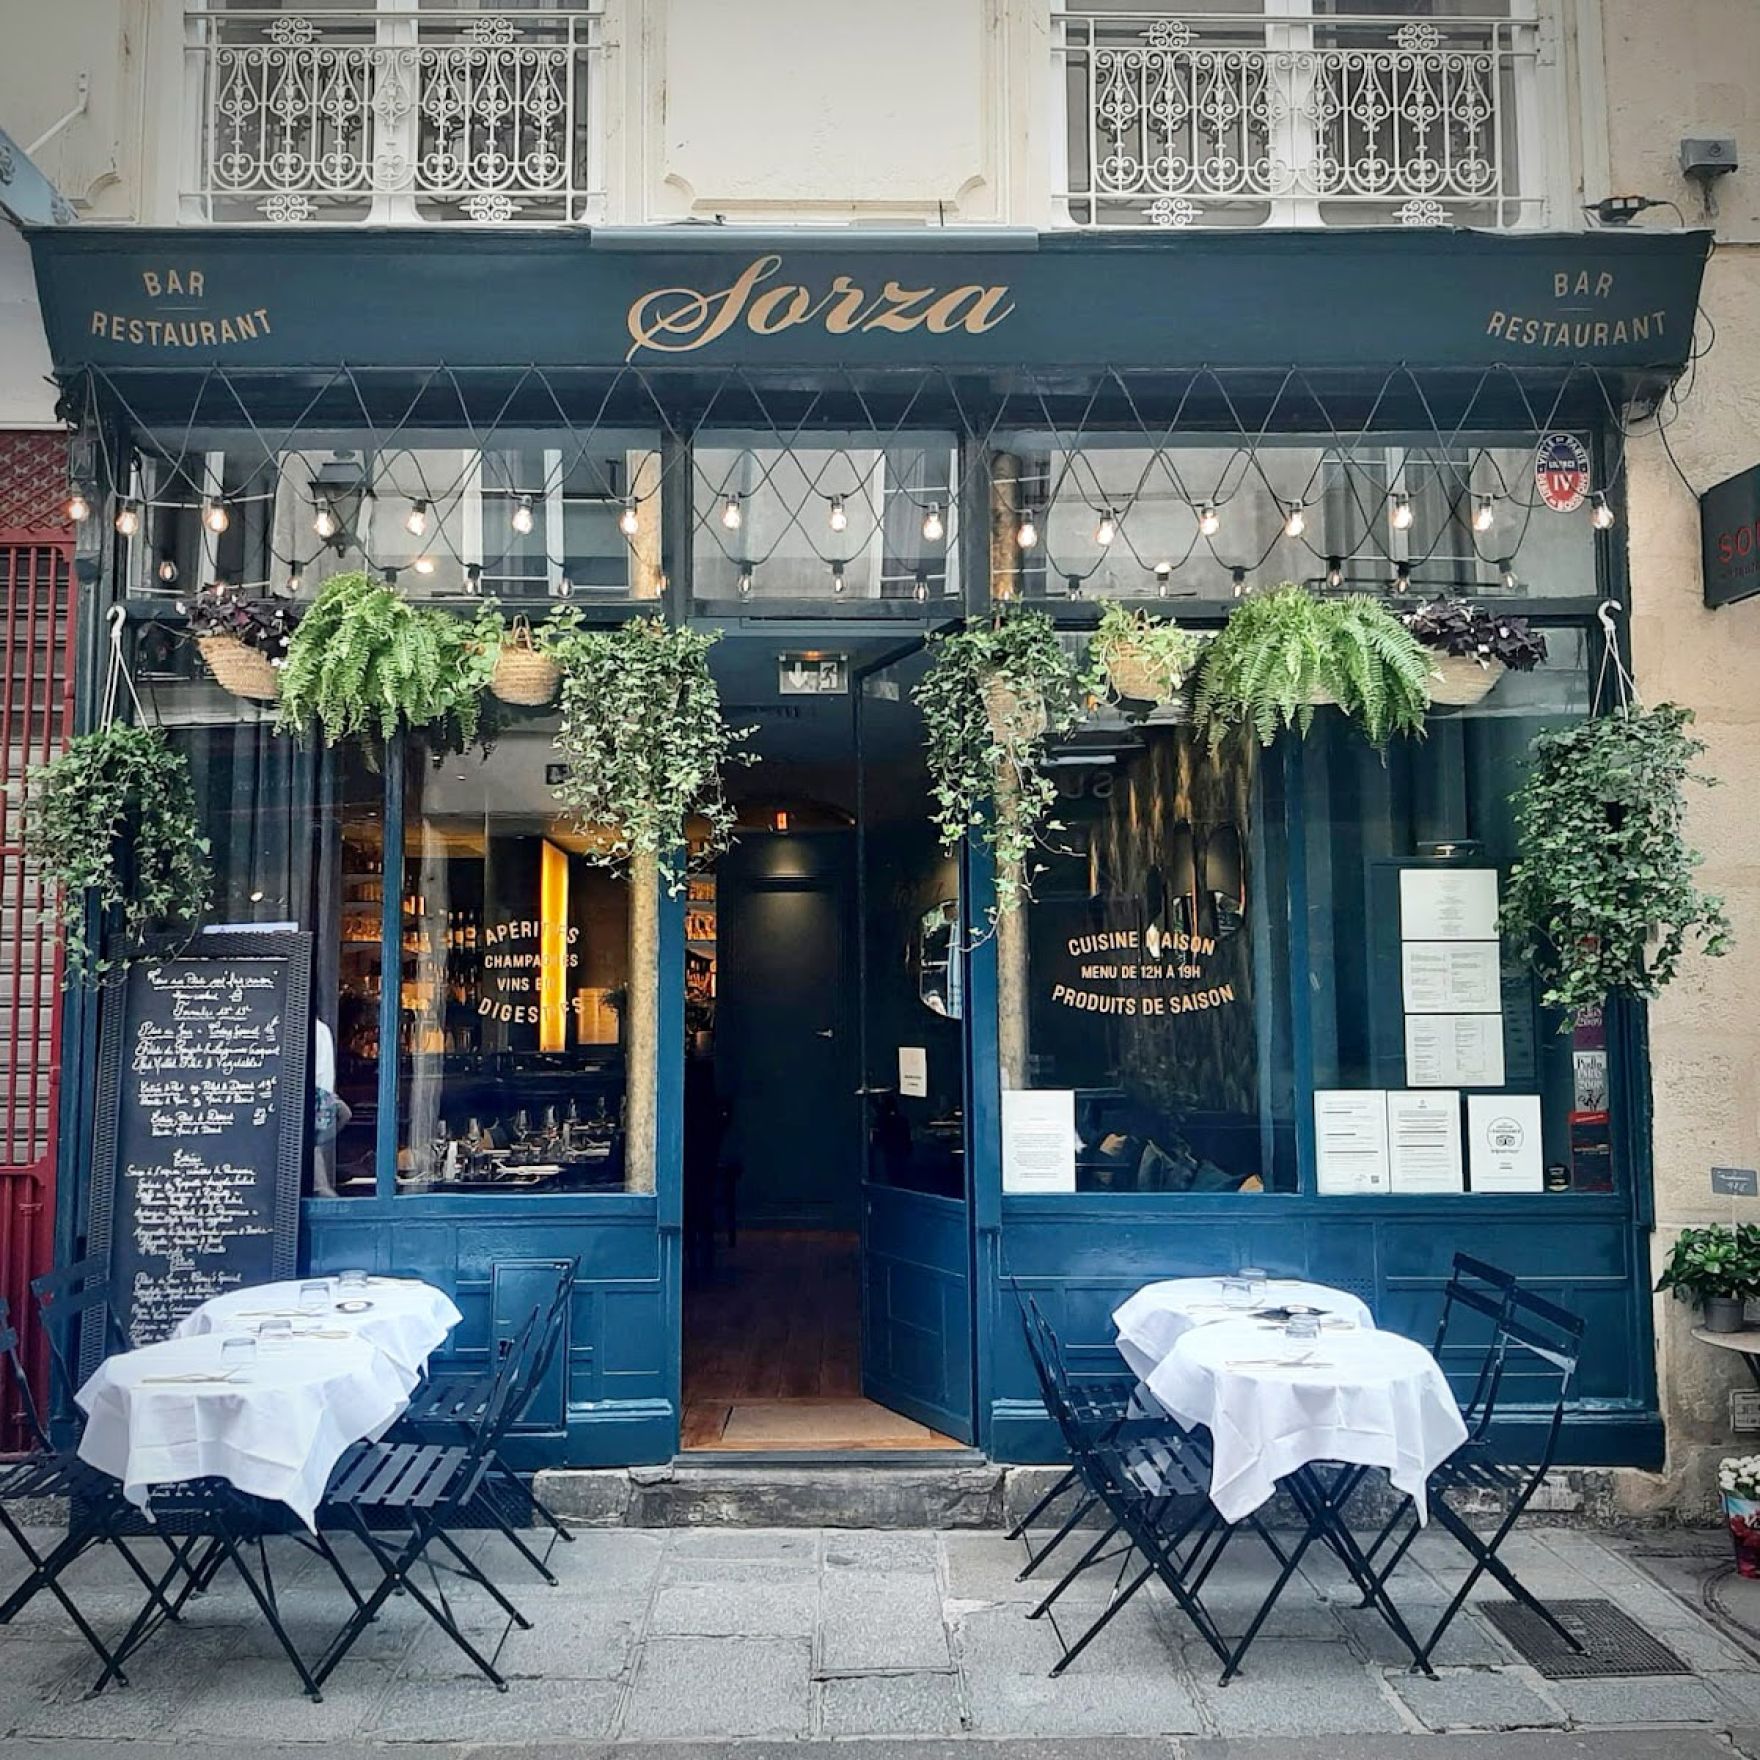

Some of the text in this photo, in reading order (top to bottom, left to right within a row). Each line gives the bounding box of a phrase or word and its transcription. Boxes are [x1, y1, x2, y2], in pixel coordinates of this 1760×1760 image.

[143, 269, 205, 297] BAR
[1554, 270, 1613, 298] BAR
[626, 254, 1016, 362] Sorza
[91, 308, 271, 347] RESTAURANT
[1486, 310, 1666, 348] RESTAURANT
[1716, 519, 1760, 565] SO
[1068, 930, 1139, 956] CUISINE
[497, 977, 530, 991] VINS
[1081, 964, 1118, 980] MENU
[1121, 964, 1137, 979] DE
[1141, 964, 1163, 979] 12H
[1052, 984, 1235, 1016] PRODUITS DE SAISON
